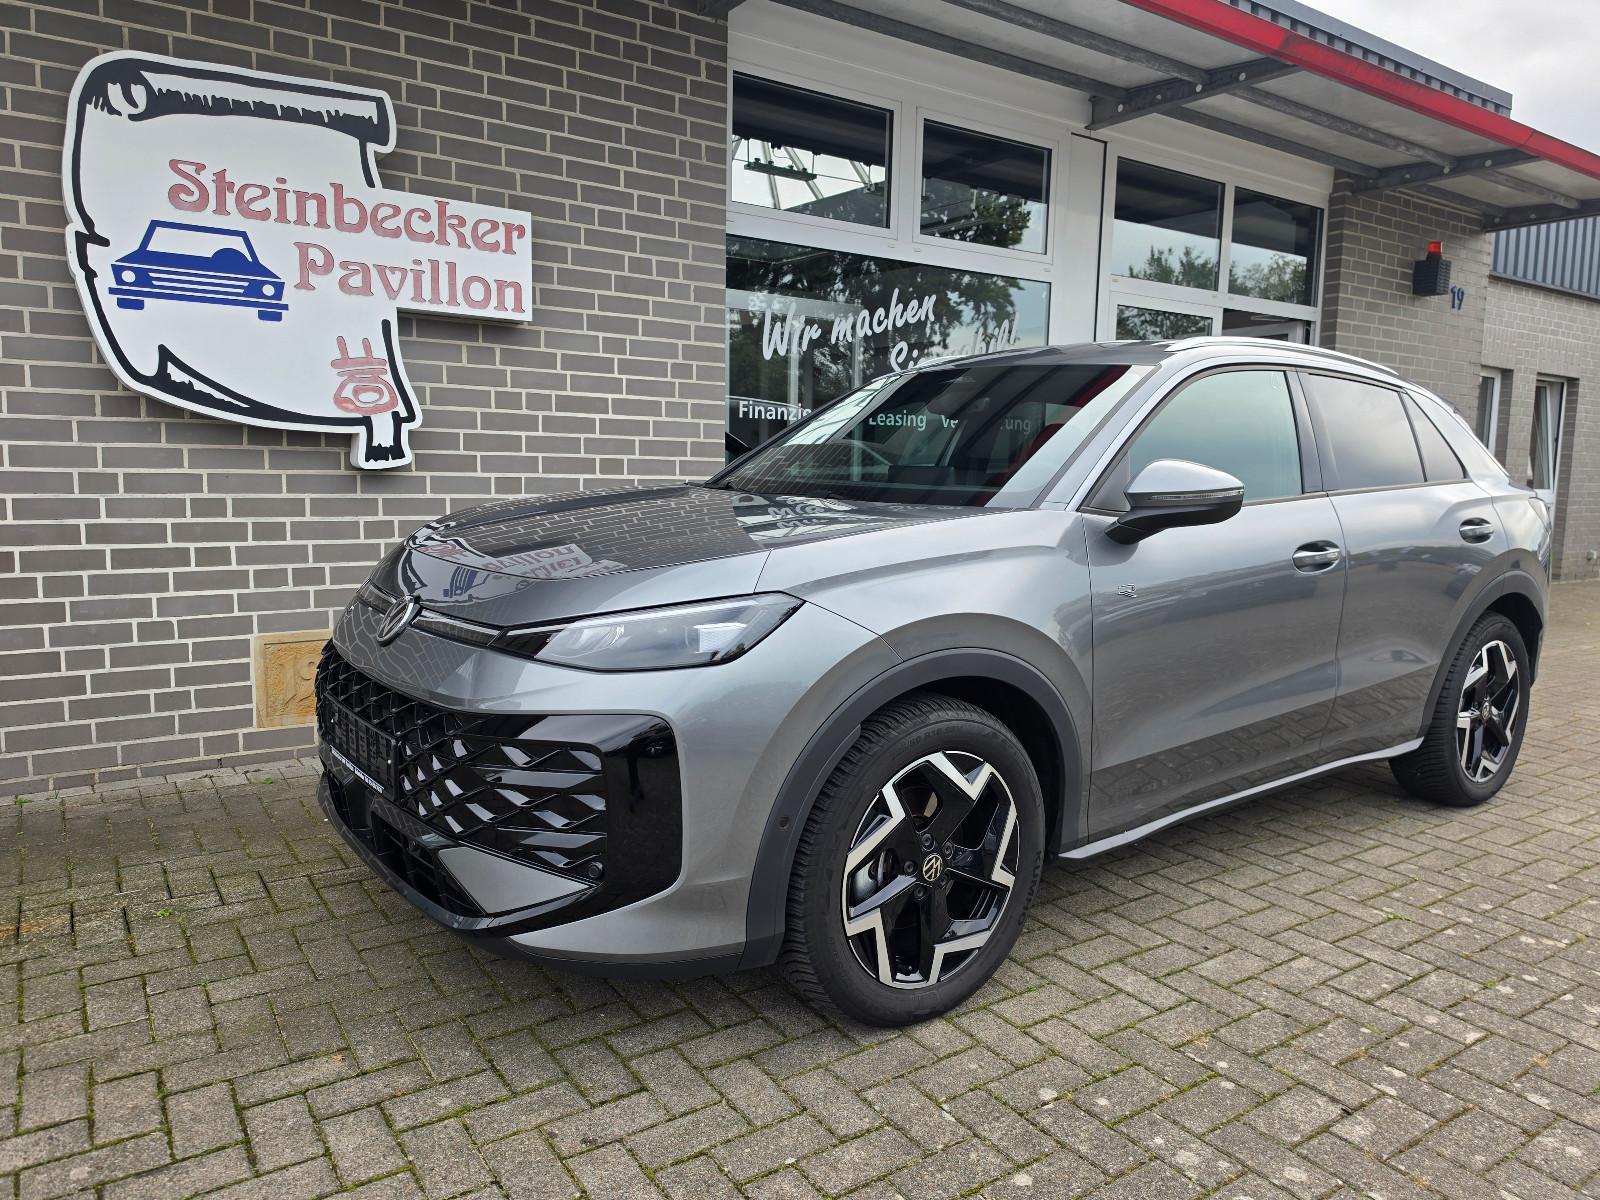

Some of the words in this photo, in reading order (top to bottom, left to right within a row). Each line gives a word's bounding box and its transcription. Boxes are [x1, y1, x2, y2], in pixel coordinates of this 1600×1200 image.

[168, 159, 526, 255] Steinbecker
[293, 242, 526, 313] Pavillon
[1451, 287, 1465, 310] 19
[763, 302, 822, 361] Wir
[831, 288, 937, 345] machen
